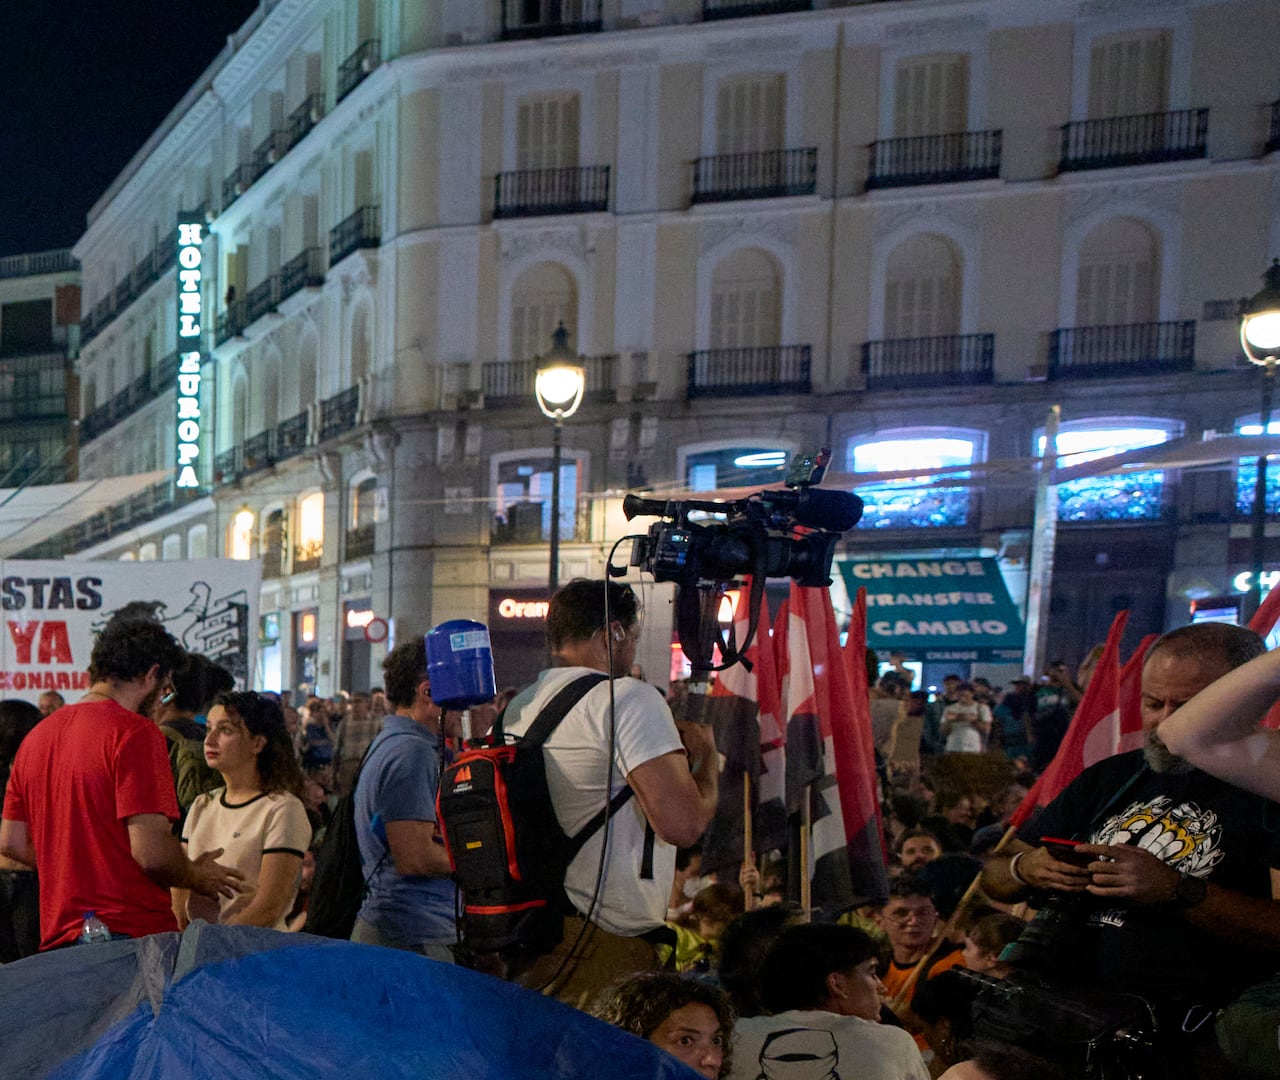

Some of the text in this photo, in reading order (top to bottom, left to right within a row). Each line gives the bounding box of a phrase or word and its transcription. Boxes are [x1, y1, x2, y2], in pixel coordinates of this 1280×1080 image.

[177, 223, 202, 487] HOTEL EUROPA
[852, 561, 985, 579] CHANGE
[498, 598, 550, 620] Oran
[872, 619, 1008, 636] CAMBIO
[7, 620, 74, 665] YA
[926, 651, 978, 661] CHANGE
